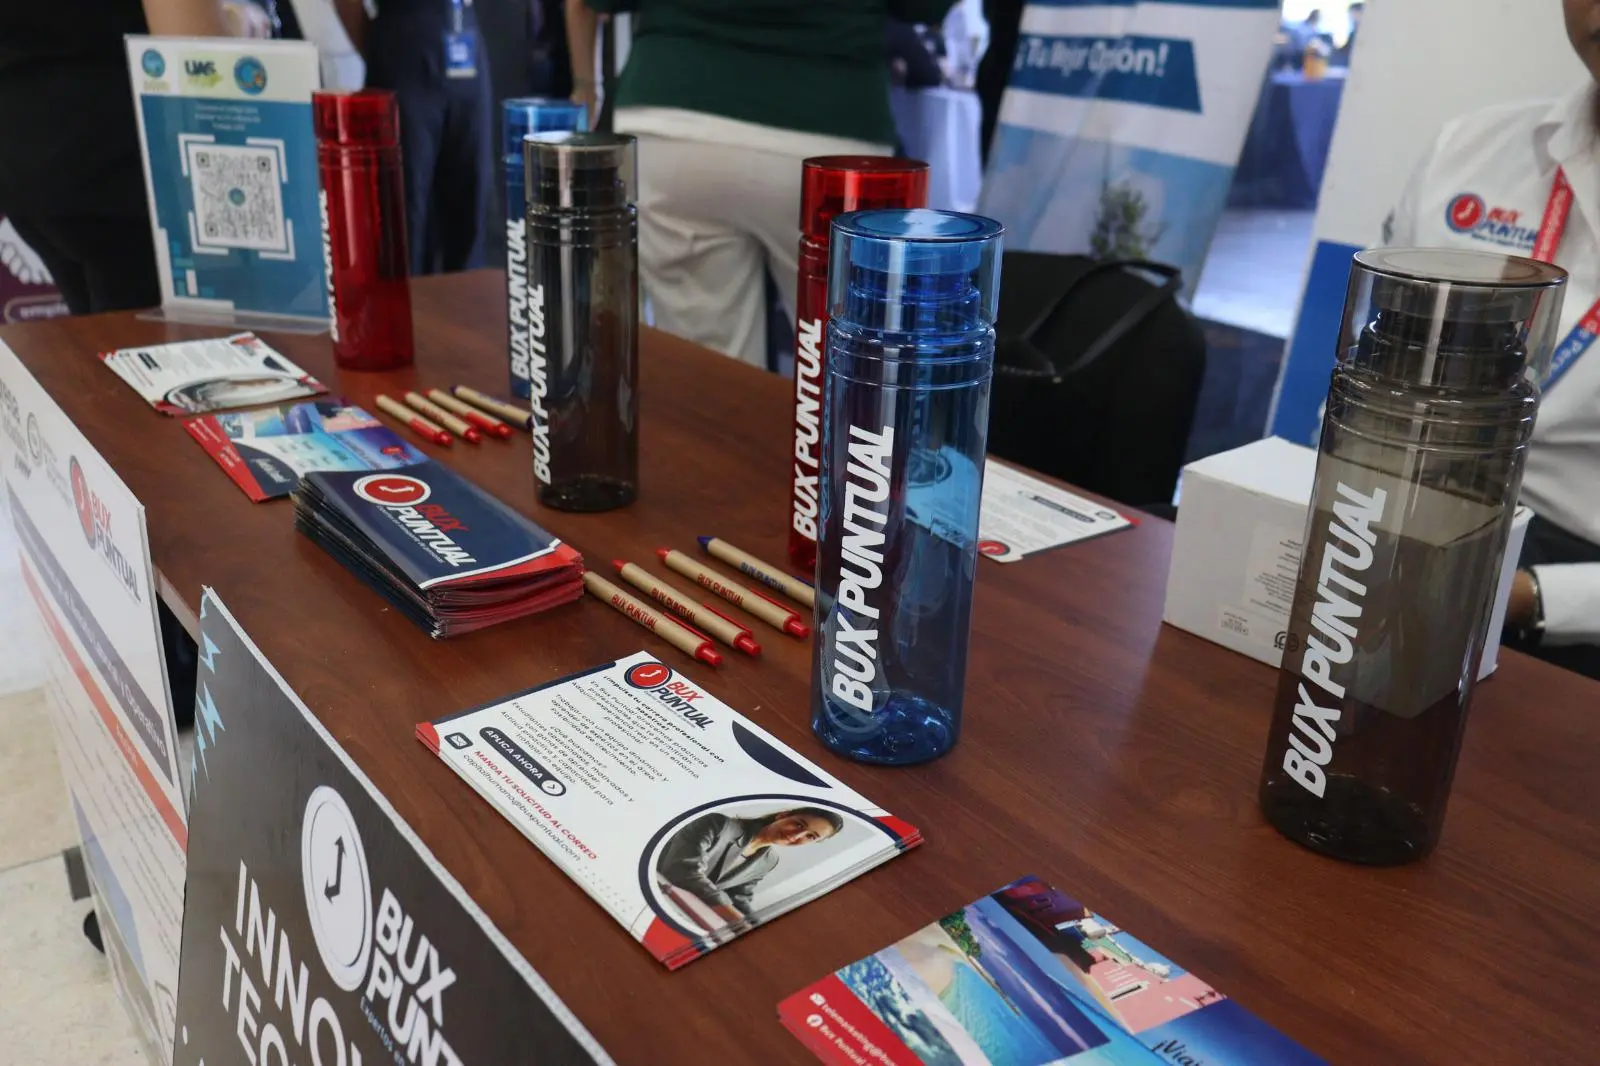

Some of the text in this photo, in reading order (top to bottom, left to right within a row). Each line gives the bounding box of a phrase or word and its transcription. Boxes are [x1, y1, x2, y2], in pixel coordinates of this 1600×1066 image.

[507, 218, 527, 328] PUNTUAL
[527, 283, 551, 485] BUX PUNTUAL
[793, 318, 822, 542] BUX PUNTUAL
[91, 490, 111, 531] BUX
[386, 506, 477, 567] PUNTUAL
[415, 504, 469, 533] BUX
[95, 521, 142, 602] PUNTUAL
[697, 573, 714, 589] BUX
[832, 424, 895, 724] BUX PUNTUAL
[611, 594, 657, 631] BUX PUNTUAL
[651, 587, 668, 602] BUX
[1282, 487, 1388, 799] BUX PUNTUAL
[549, 707, 587, 735] Posibilidad
[586, 687, 632, 720] profesionales
[629, 719, 646, 730] que
[651, 688, 714, 730] PUNTUAL
[667, 681, 704, 703] BUX
[510, 701, 549, 731] Estudiantes
[588, 766, 630, 798] motivados
[523, 722, 540, 733] con
[536, 732, 560, 749] ganas
[549, 698, 582, 722] aprender
[587, 729, 620, 752] expertos
[553, 693, 585, 715] Trabajar
[580, 714, 597, 725] con
[602, 731, 631, 751] equipo
[594, 701, 636, 730] experiencia
[631, 729, 650, 741] real
[667, 755, 701, 779] entorno
[634, 714, 675, 742] ofrecemos
[639, 702, 669, 722] carrera
[665, 721, 710, 752] profesional
[706, 751, 726, 763] con
[483, 728, 545, 779] APLICA AHORA
[499, 710, 525, 730] Actitud
[556, 758, 597, 790] capacidad
[593, 789, 616, 806] para
[461, 753, 583, 862] capitalhumano@buxpuntual.com
[472, 750, 598, 860] MANDA TU SOLICITUD AL CORREO
[235, 859, 362, 1066] INNO
[376, 887, 456, 1027] BUX
[361, 996, 393, 1053] Expertos
[819, 1023, 836, 1040] Bux
